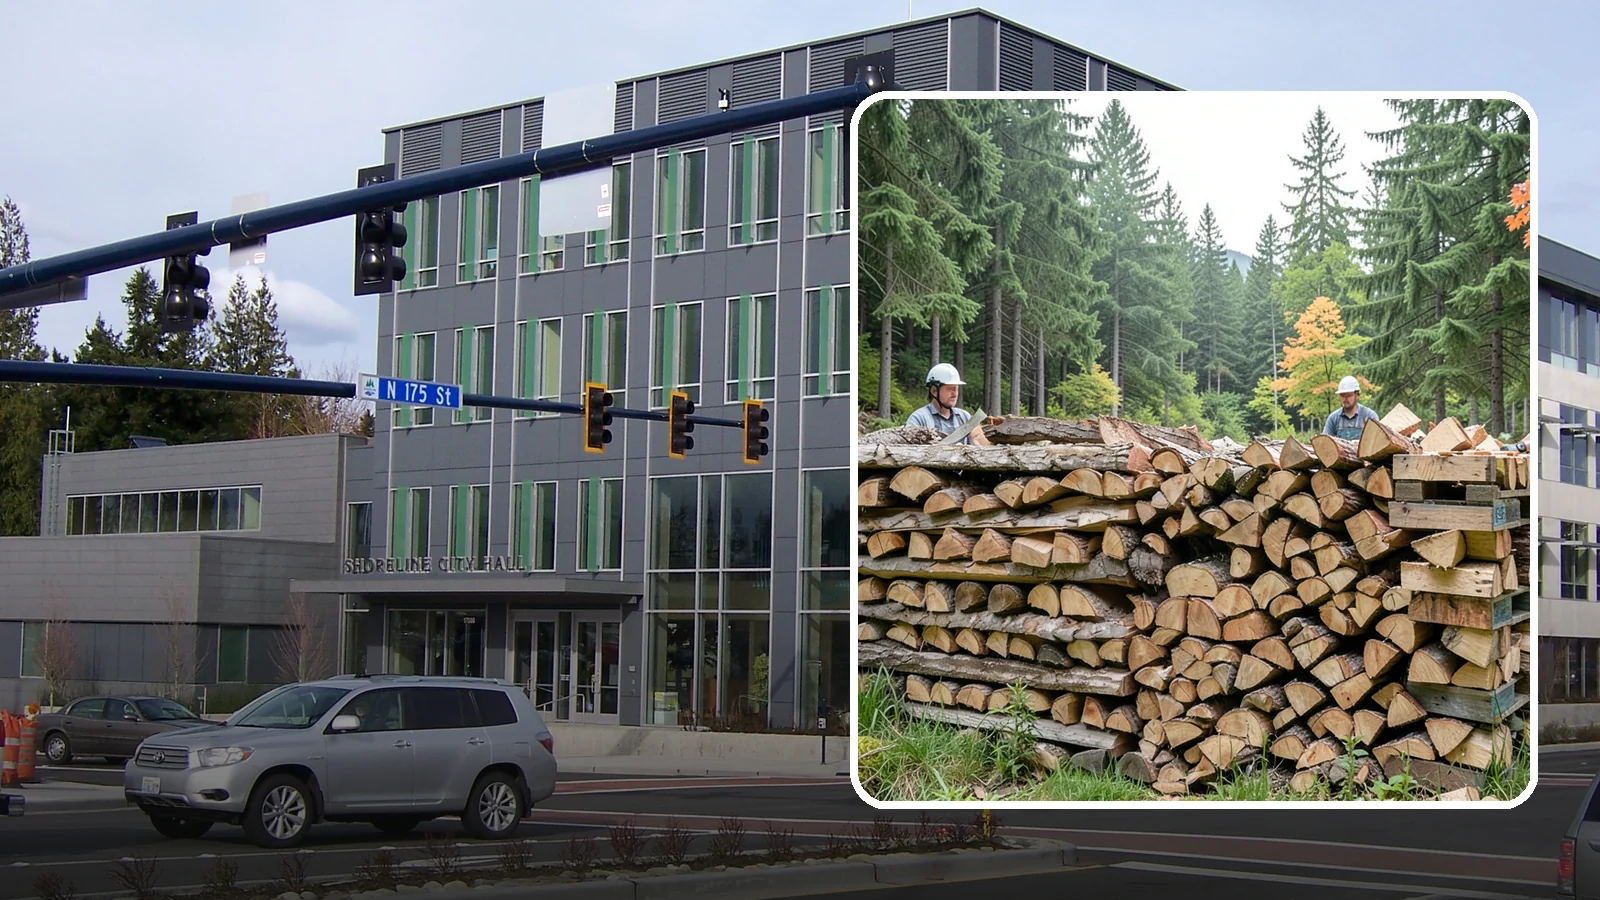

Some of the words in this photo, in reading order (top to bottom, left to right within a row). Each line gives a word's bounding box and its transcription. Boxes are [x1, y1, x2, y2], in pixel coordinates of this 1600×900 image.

[387, 381, 396, 400] N
[405, 383, 427, 403] 175
[436, 386, 451, 406] St
[344, 557, 432, 574] SHORELINE
[438, 555, 477, 572] CITY
[484, 555, 526, 572] HALL
